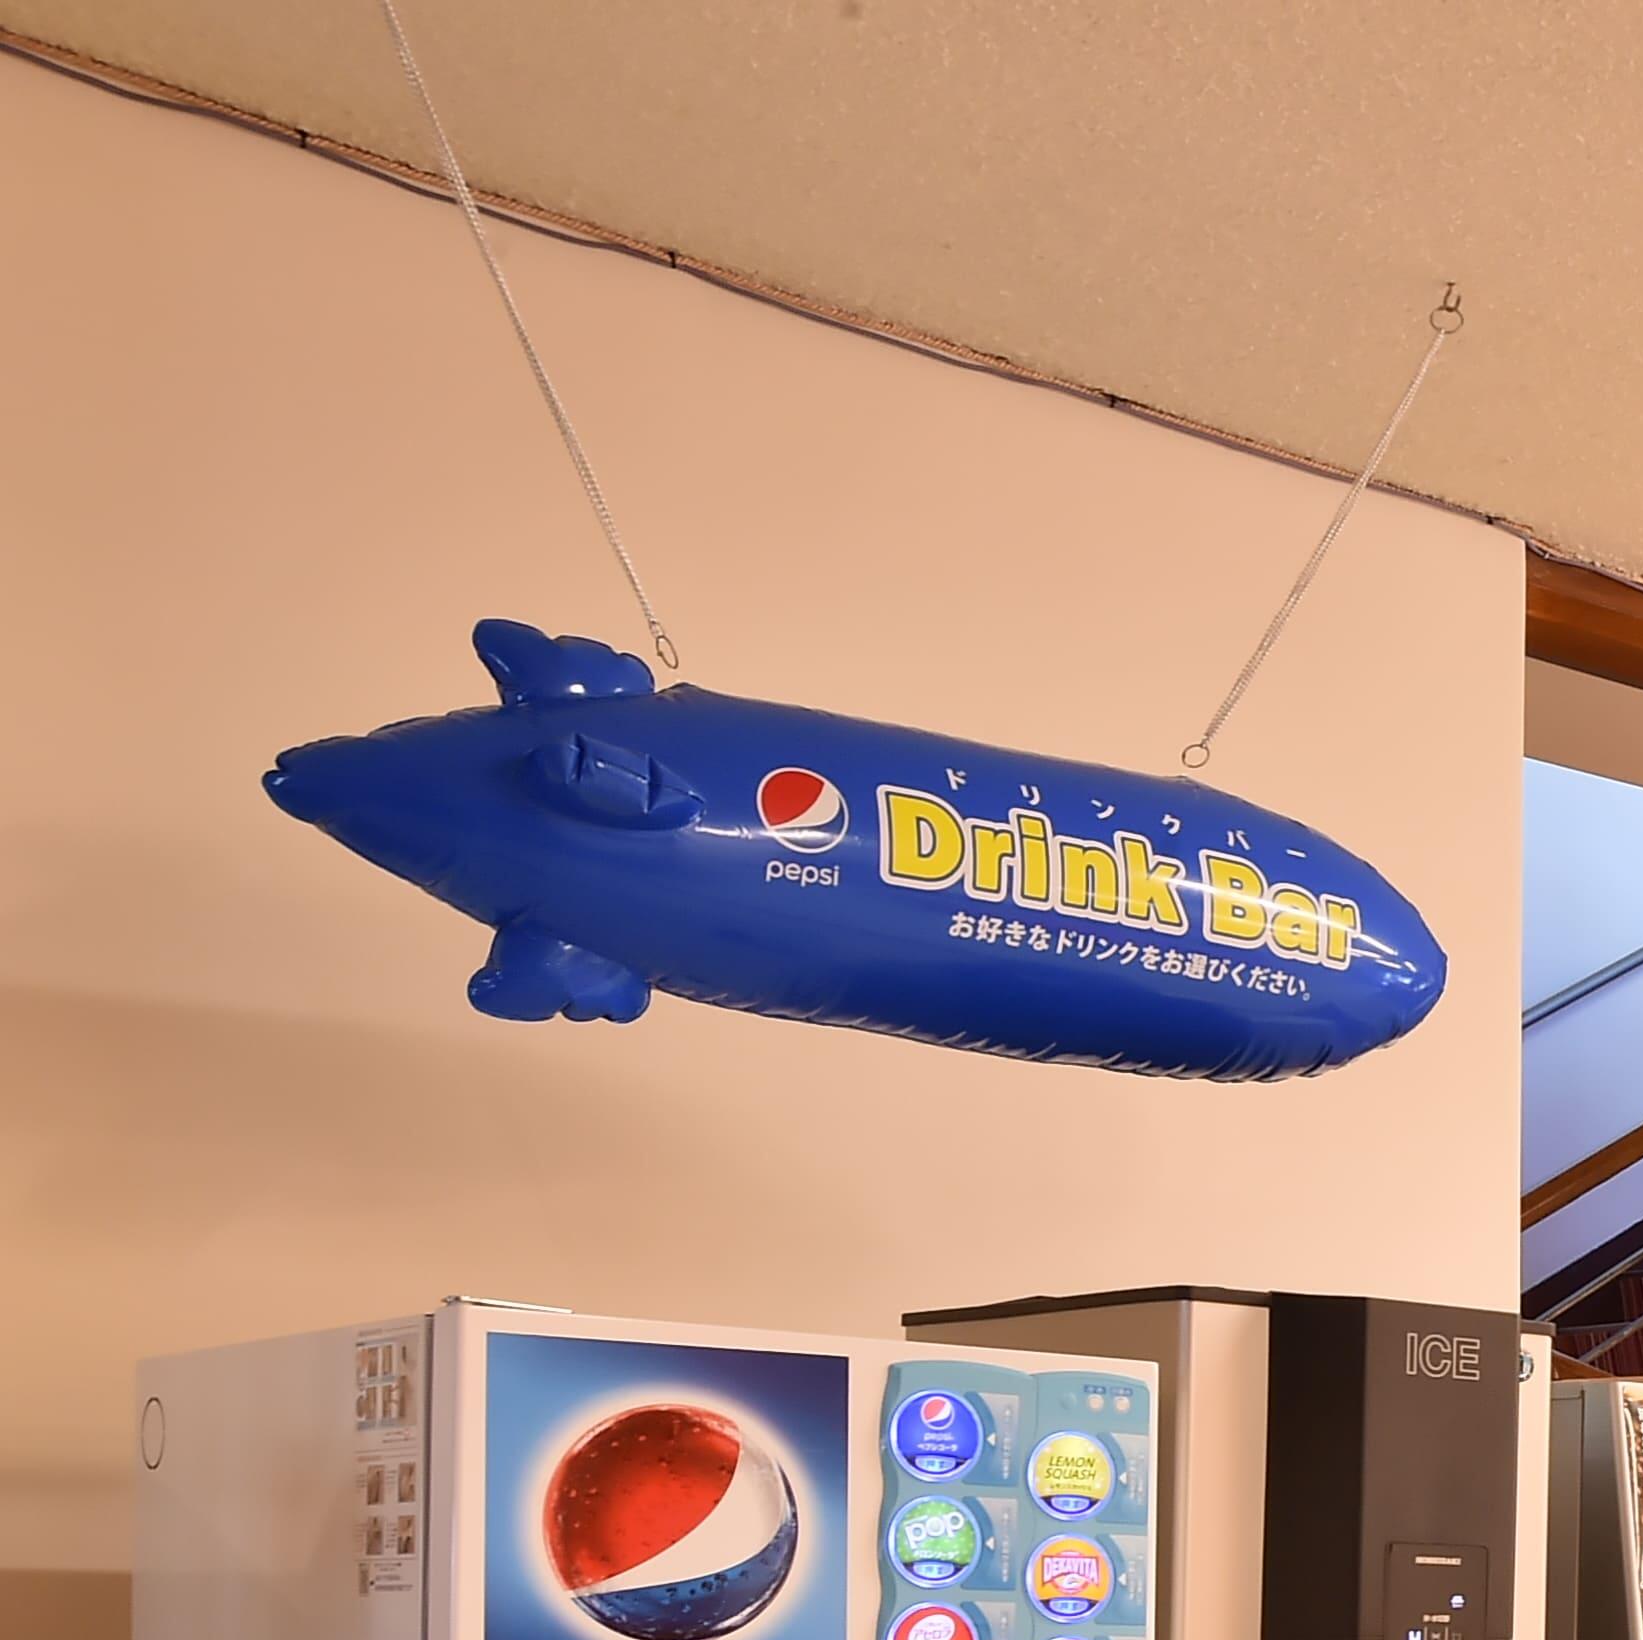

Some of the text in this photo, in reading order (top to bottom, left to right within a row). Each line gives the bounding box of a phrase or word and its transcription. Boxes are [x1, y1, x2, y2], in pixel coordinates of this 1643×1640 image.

[945, 767, 1308, 860] ドリンクバー
[765, 859, 840, 888] pepsi
[879, 785, 1359, 968] Drink Bar
[1406, 1332, 1481, 1381] ICE
[1044, 1468, 1097, 1480] SQUASH
[1048, 1456, 1096, 1468] LEMON
